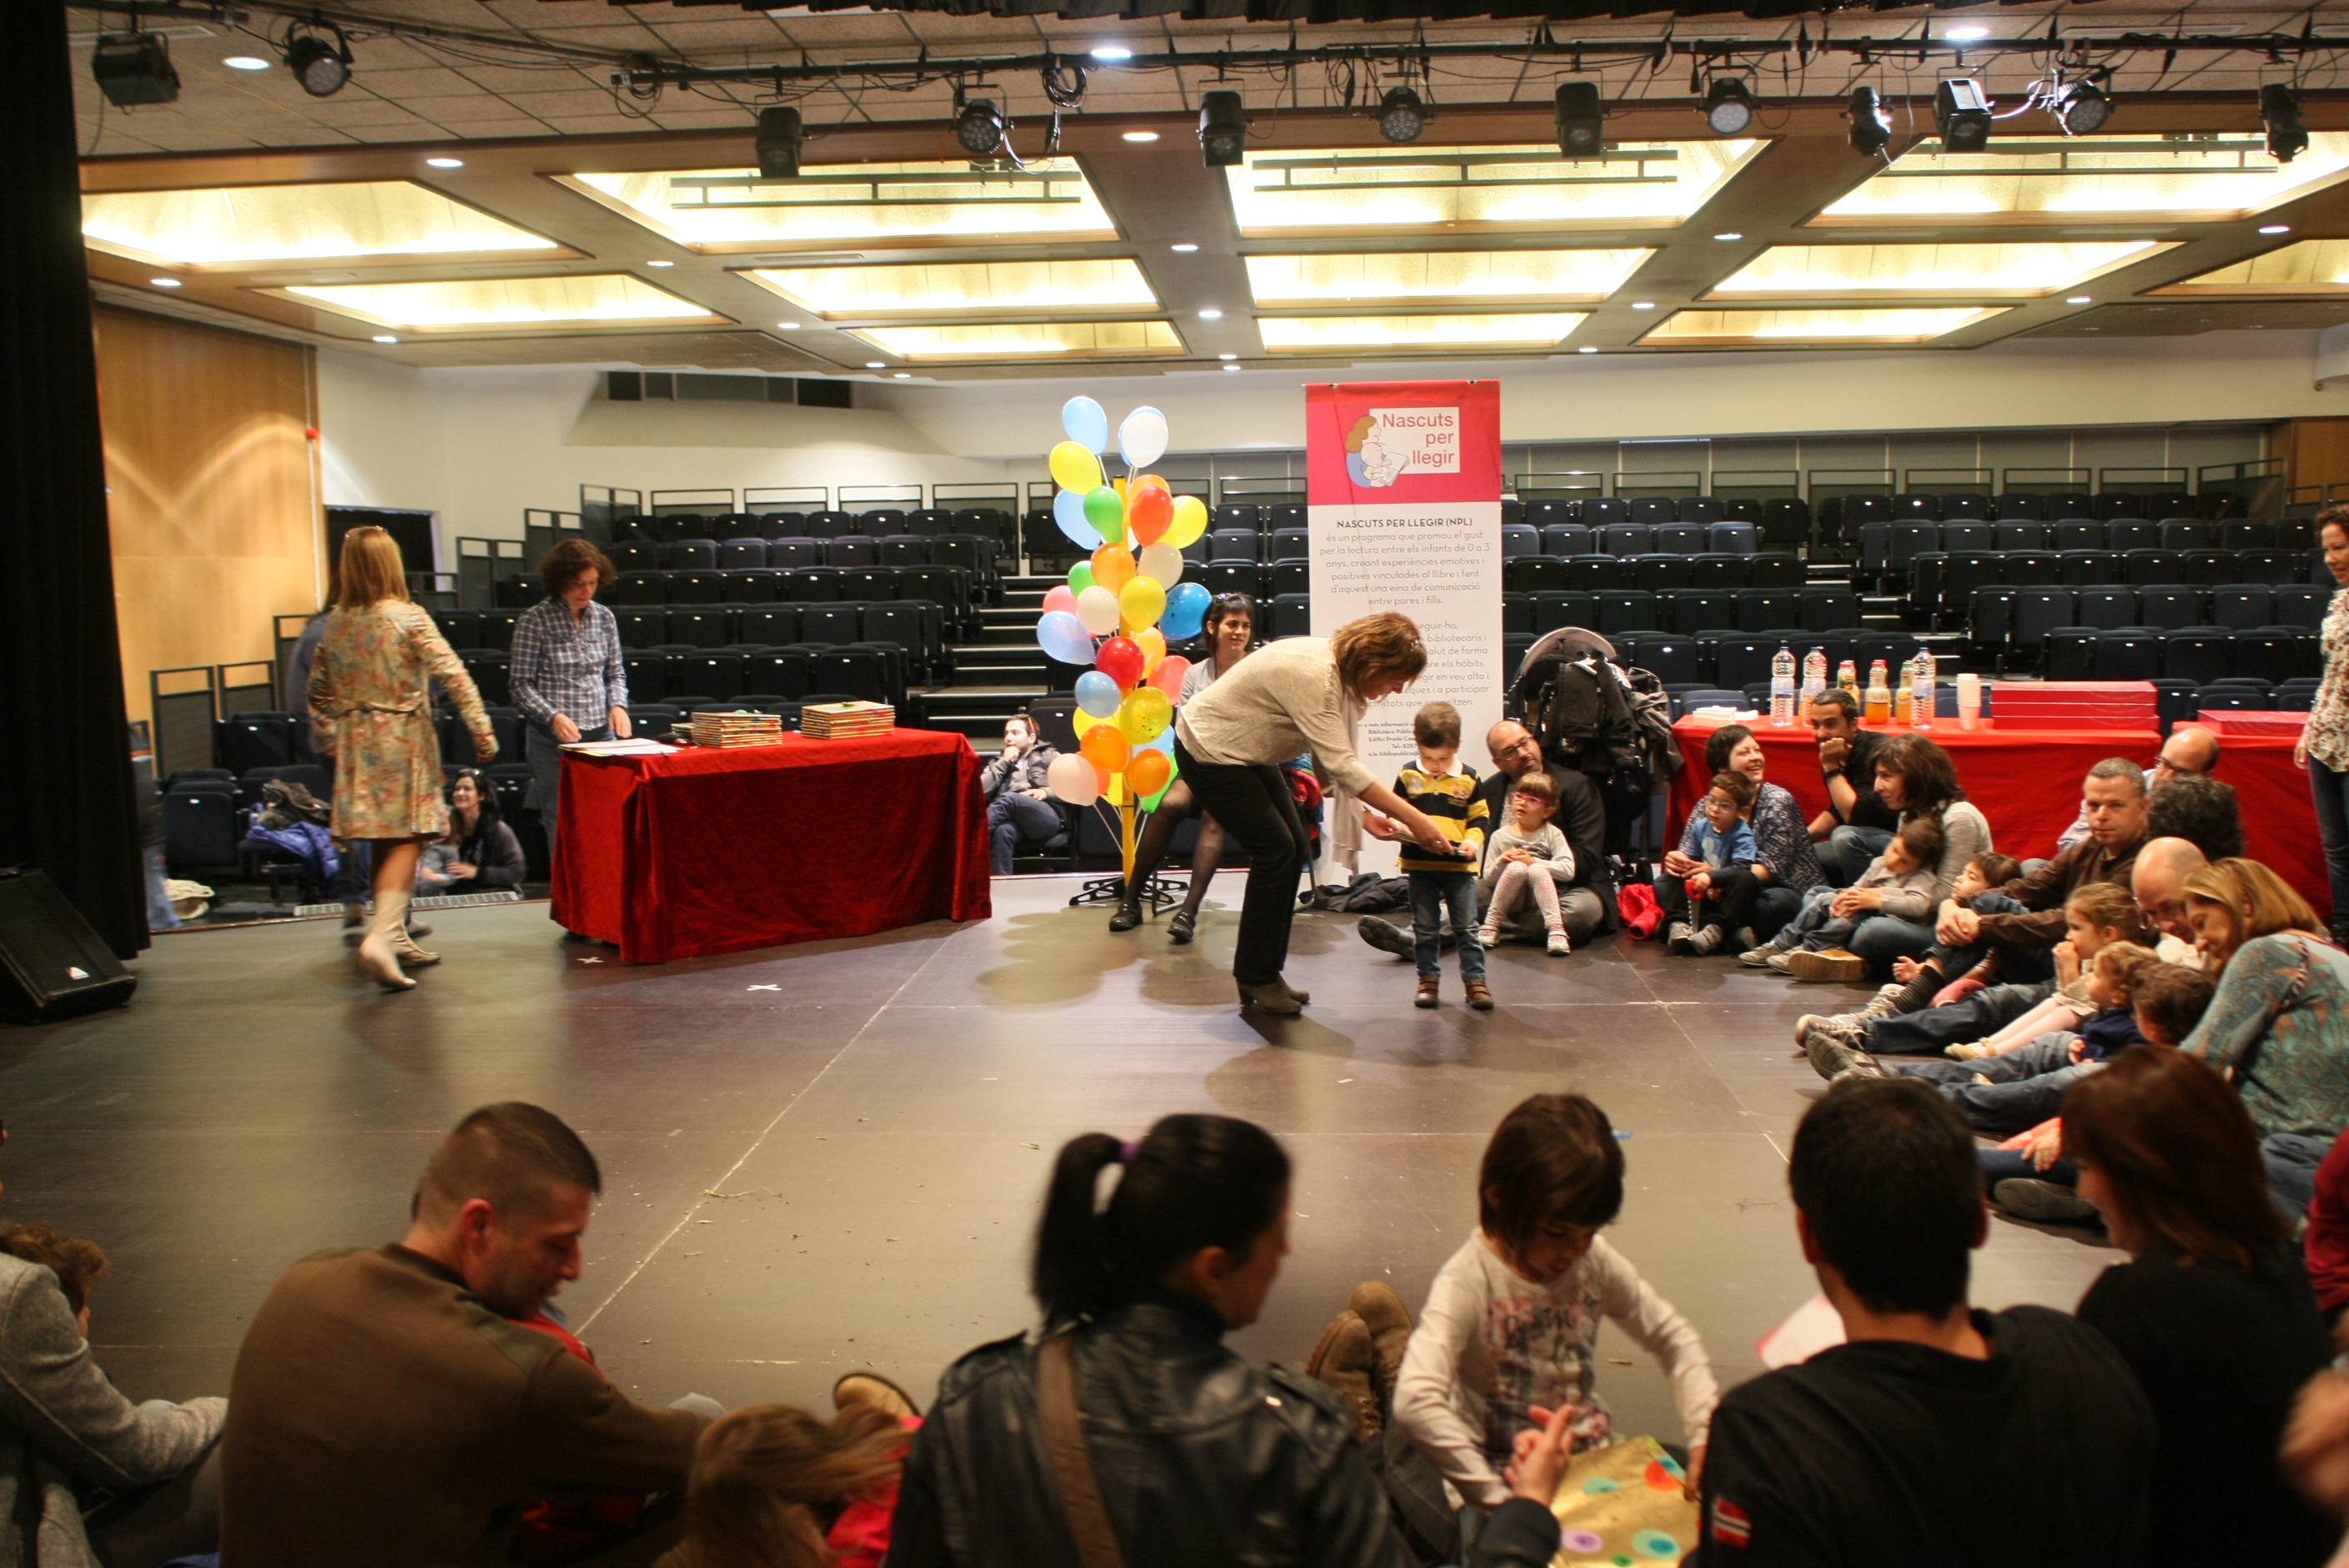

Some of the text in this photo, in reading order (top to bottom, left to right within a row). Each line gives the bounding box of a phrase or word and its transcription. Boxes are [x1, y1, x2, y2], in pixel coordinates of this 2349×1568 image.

[1383, 414, 1453, 427] Nascuts
[1426, 432, 1454, 447] per
[1412, 450, 1454, 468] llegir
[1337, 517, 1472, 528] NASCUTS PER LLEGIR (NPL)
[1351, 534, 1396, 543] programa
[1398, 534, 1415, 542] que
[1417, 533, 1451, 541] promou
[1454, 531, 1461, 540] el
[1464, 530, 1483, 540] gust
[1320, 548, 1335, 556] per
[1337, 546, 1346, 555] la
[1348, 545, 1379, 555] lectura
[1407, 545, 1419, 553] els
[1421, 544, 1452, 552] infants
[1454, 543, 1466, 552] de
[1467, 543, 1474, 551] 0
[1484, 543, 1490, 551] 3
[1325, 560, 1348, 569] anys,
[1382, 556, 1437, 567] experiències
[1440, 556, 1480, 565] emotives
[1482, 556, 1484, 565] i
[1331, 572, 1371, 581] positives
[1373, 570, 1420, 580] vinculades
[1432, 570, 1455, 578] llibre
[1461, 569, 1479, 577] fent
[1331, 584, 1369, 594] d'aquest
[1411, 583, 1422, 591] de
[1425, 581, 1480, 591] comunicació
[1395, 598, 1419, 606] pares
[1421, 596, 1424, 604] i
[1426, 595, 1443, 604] fills.
[1427, 633, 1481, 643] bibliotecaris
[1484, 633, 1487, 641] i
[1448, 646, 1460, 654] de
[1461, 646, 1488, 655] forma
[1456, 659, 1483, 667] hàbits
[1467, 671, 1485, 680] alta
[1487, 671, 1490, 680] i
[1433, 685, 1436, 693] i
[1446, 685, 1490, 695] participar
[1406, 700, 1421, 708] que
